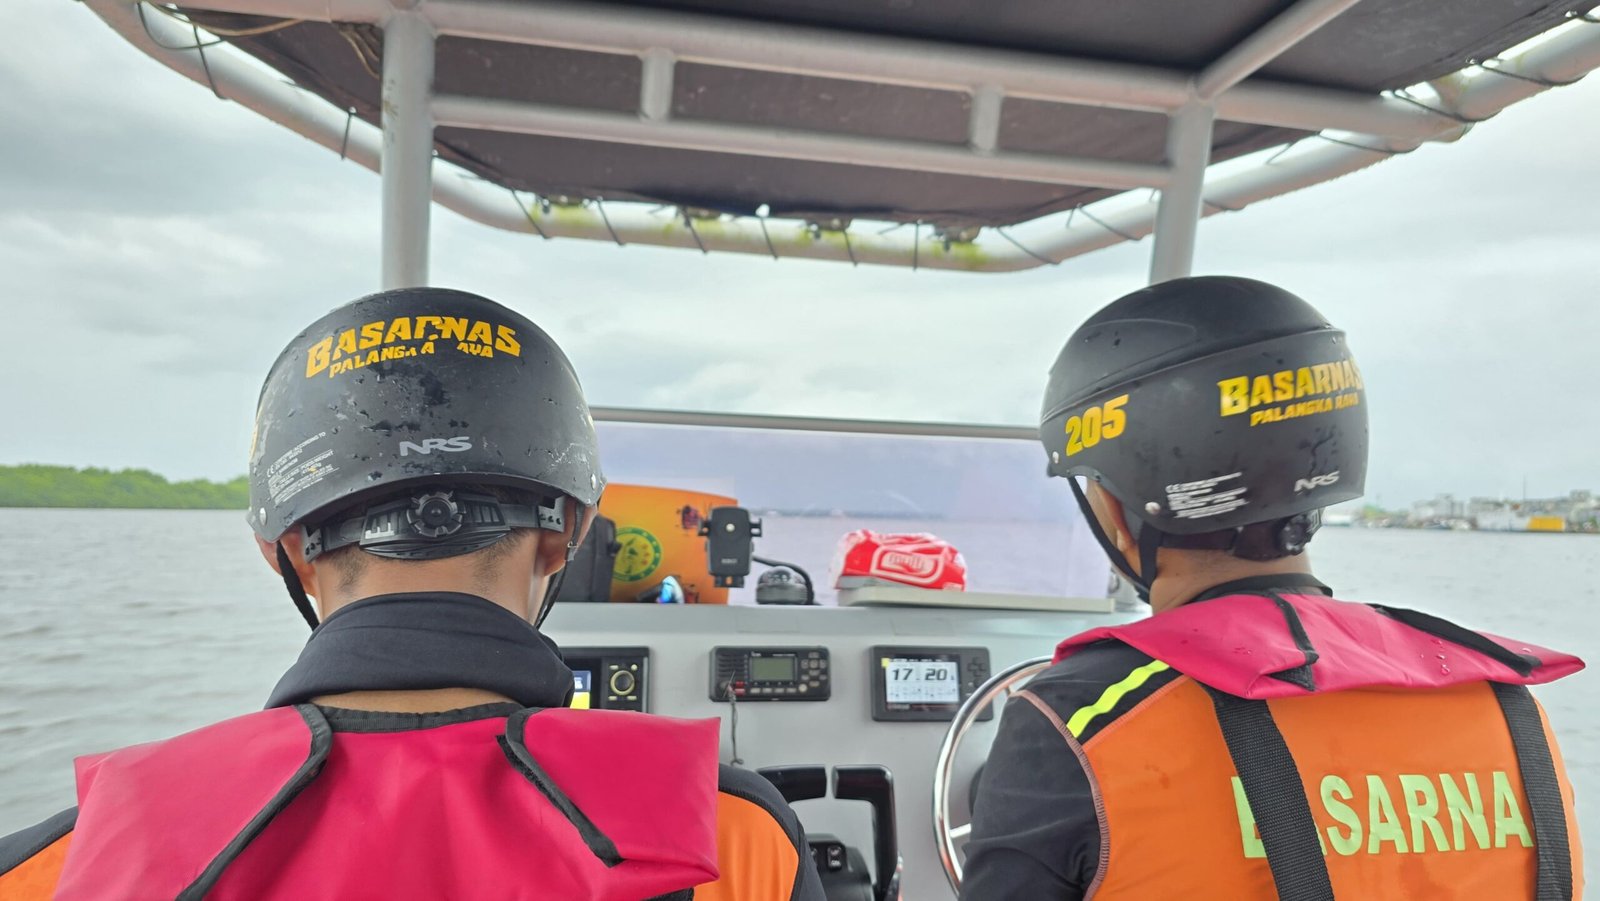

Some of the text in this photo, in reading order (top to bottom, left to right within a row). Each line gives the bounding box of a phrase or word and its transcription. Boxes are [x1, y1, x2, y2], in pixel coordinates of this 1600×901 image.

[456, 341, 494, 358] AYA
[1064, 394, 1129, 457] 205
[400, 436, 473, 457] NRS
[1294, 470, 1340, 492] NRS
[925, 668, 948, 681] 20
[1231, 771, 1534, 858] SARNA
